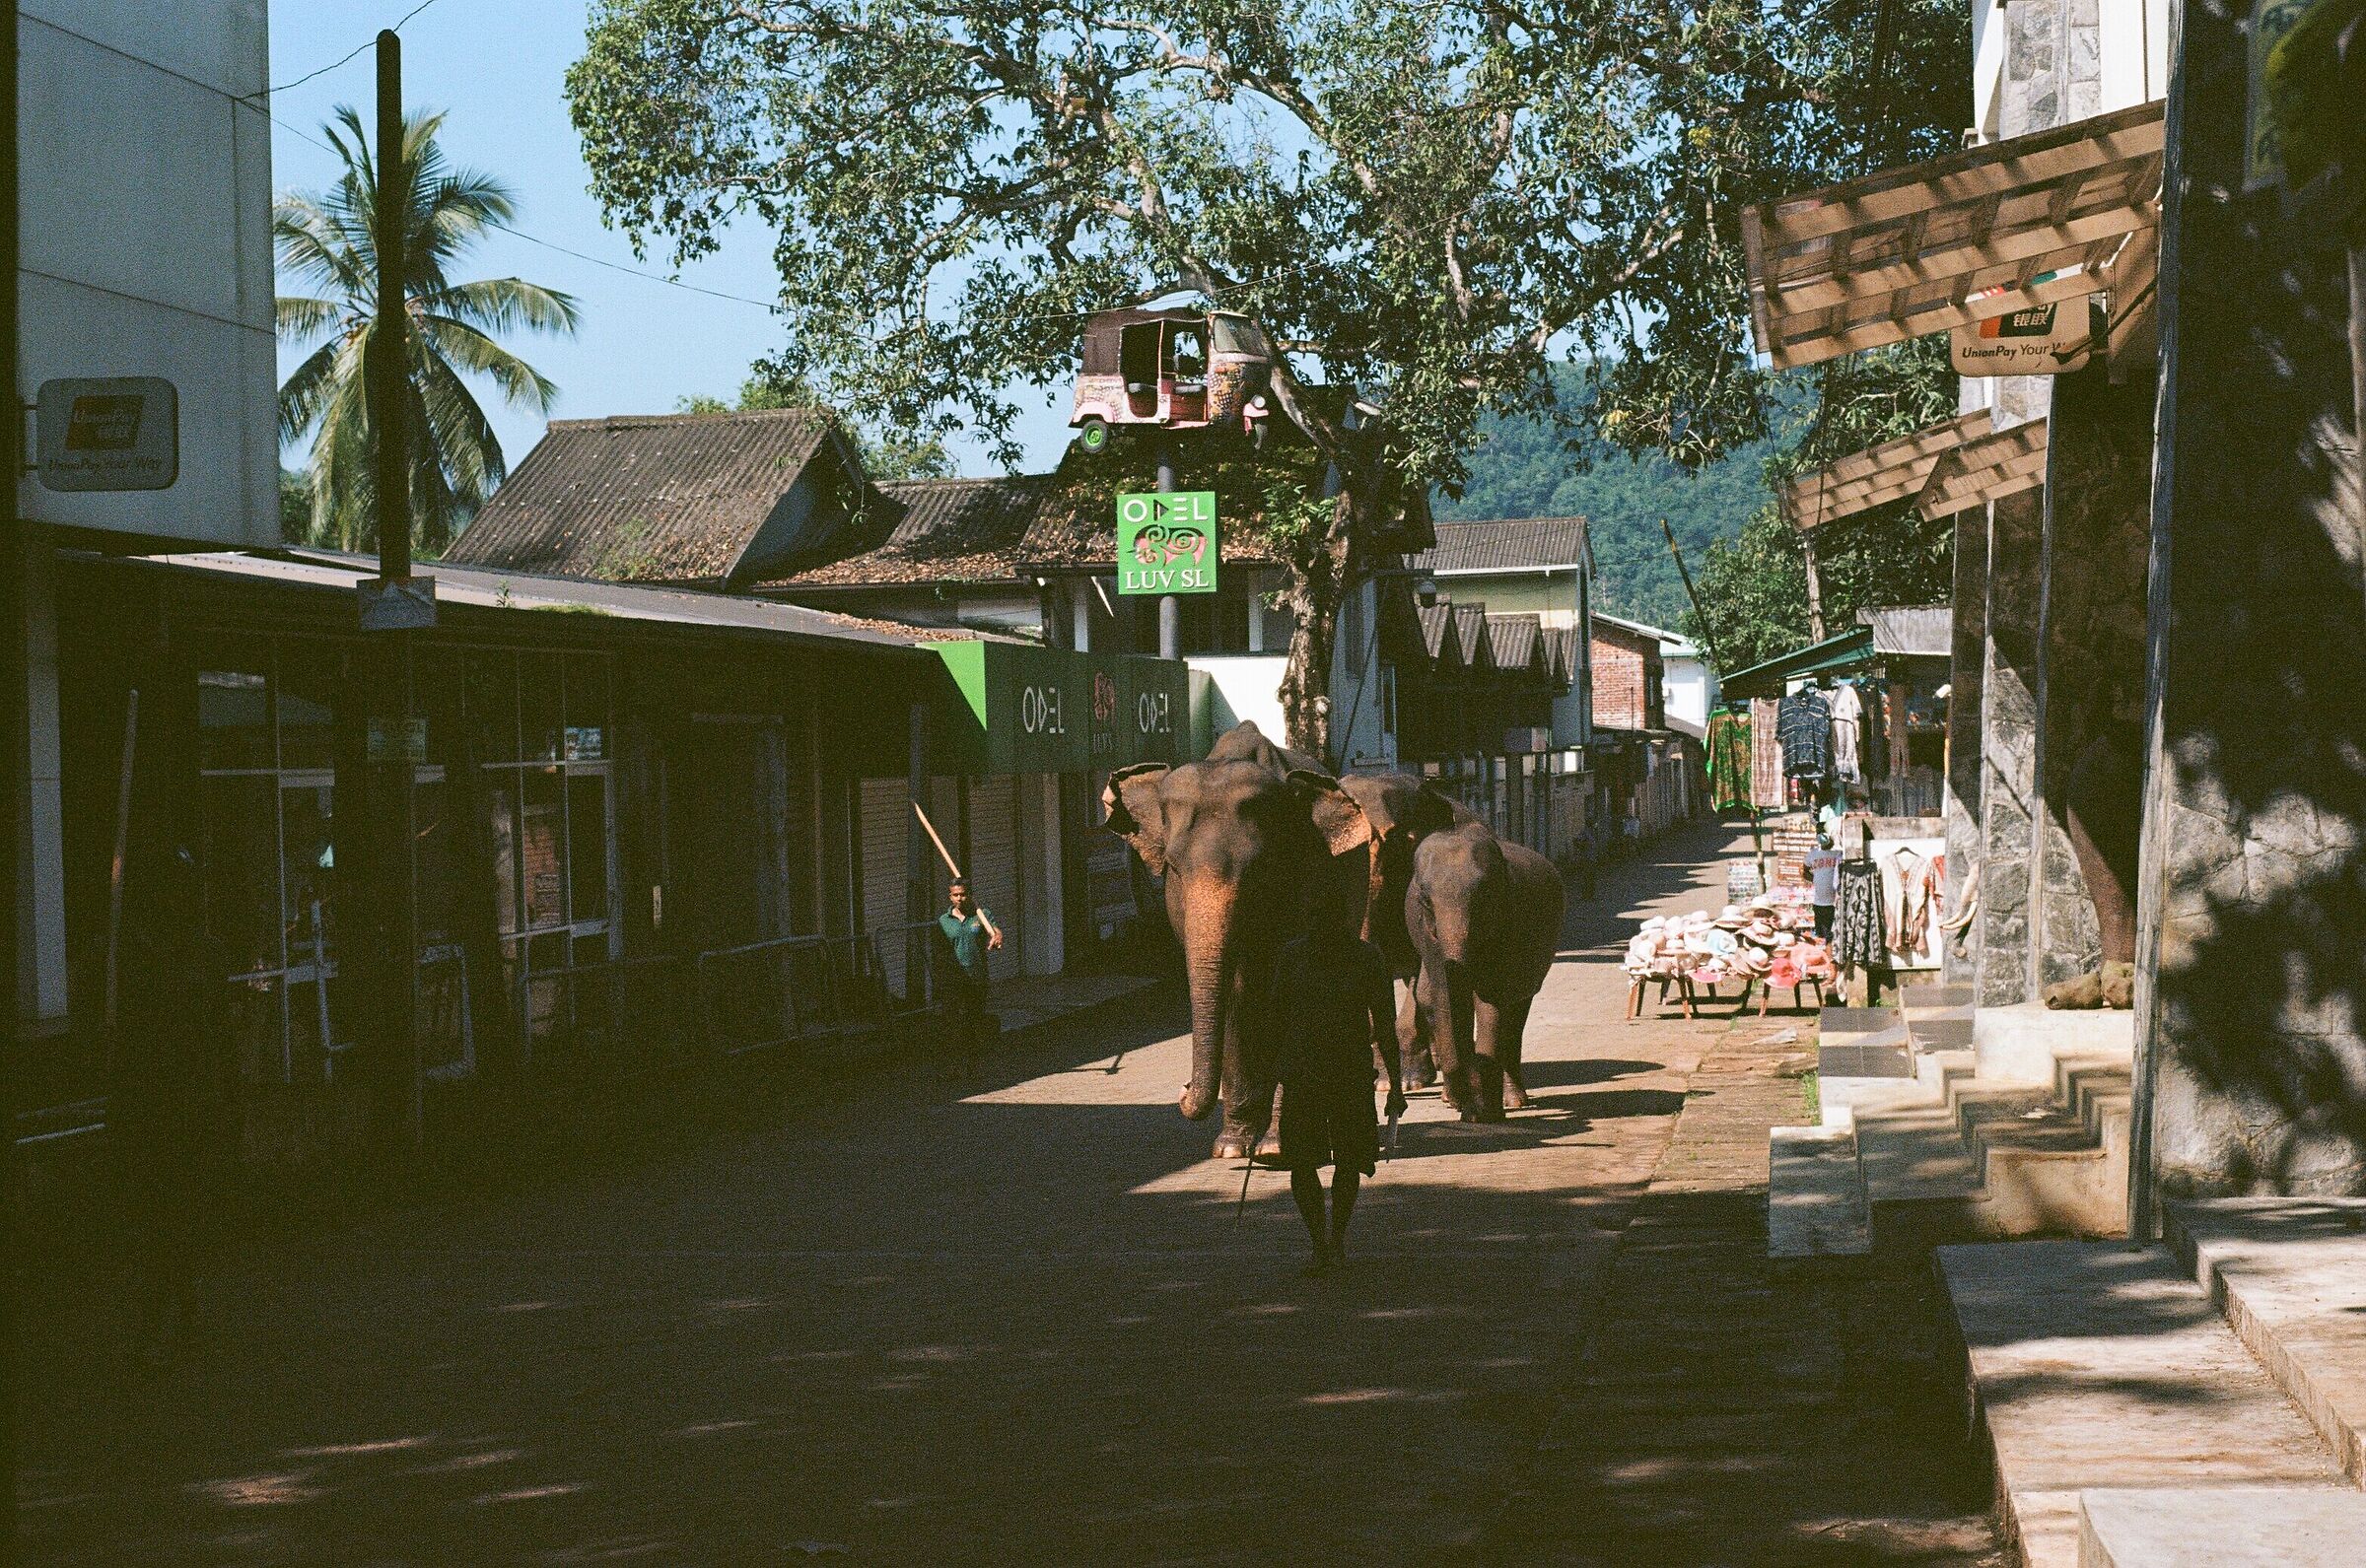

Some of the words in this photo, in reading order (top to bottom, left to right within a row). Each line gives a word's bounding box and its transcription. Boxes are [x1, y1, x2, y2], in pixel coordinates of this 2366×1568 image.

[2013, 312, 2048, 326] 银联
[1962, 346, 2017, 361] UnionPay
[2020, 343, 2050, 357] Your
[1125, 570, 1175, 590] LUV
[1181, 568, 1210, 589] SL
[1022, 686, 1065, 734] ODEL
[1139, 693, 1171, 733] ODEL
